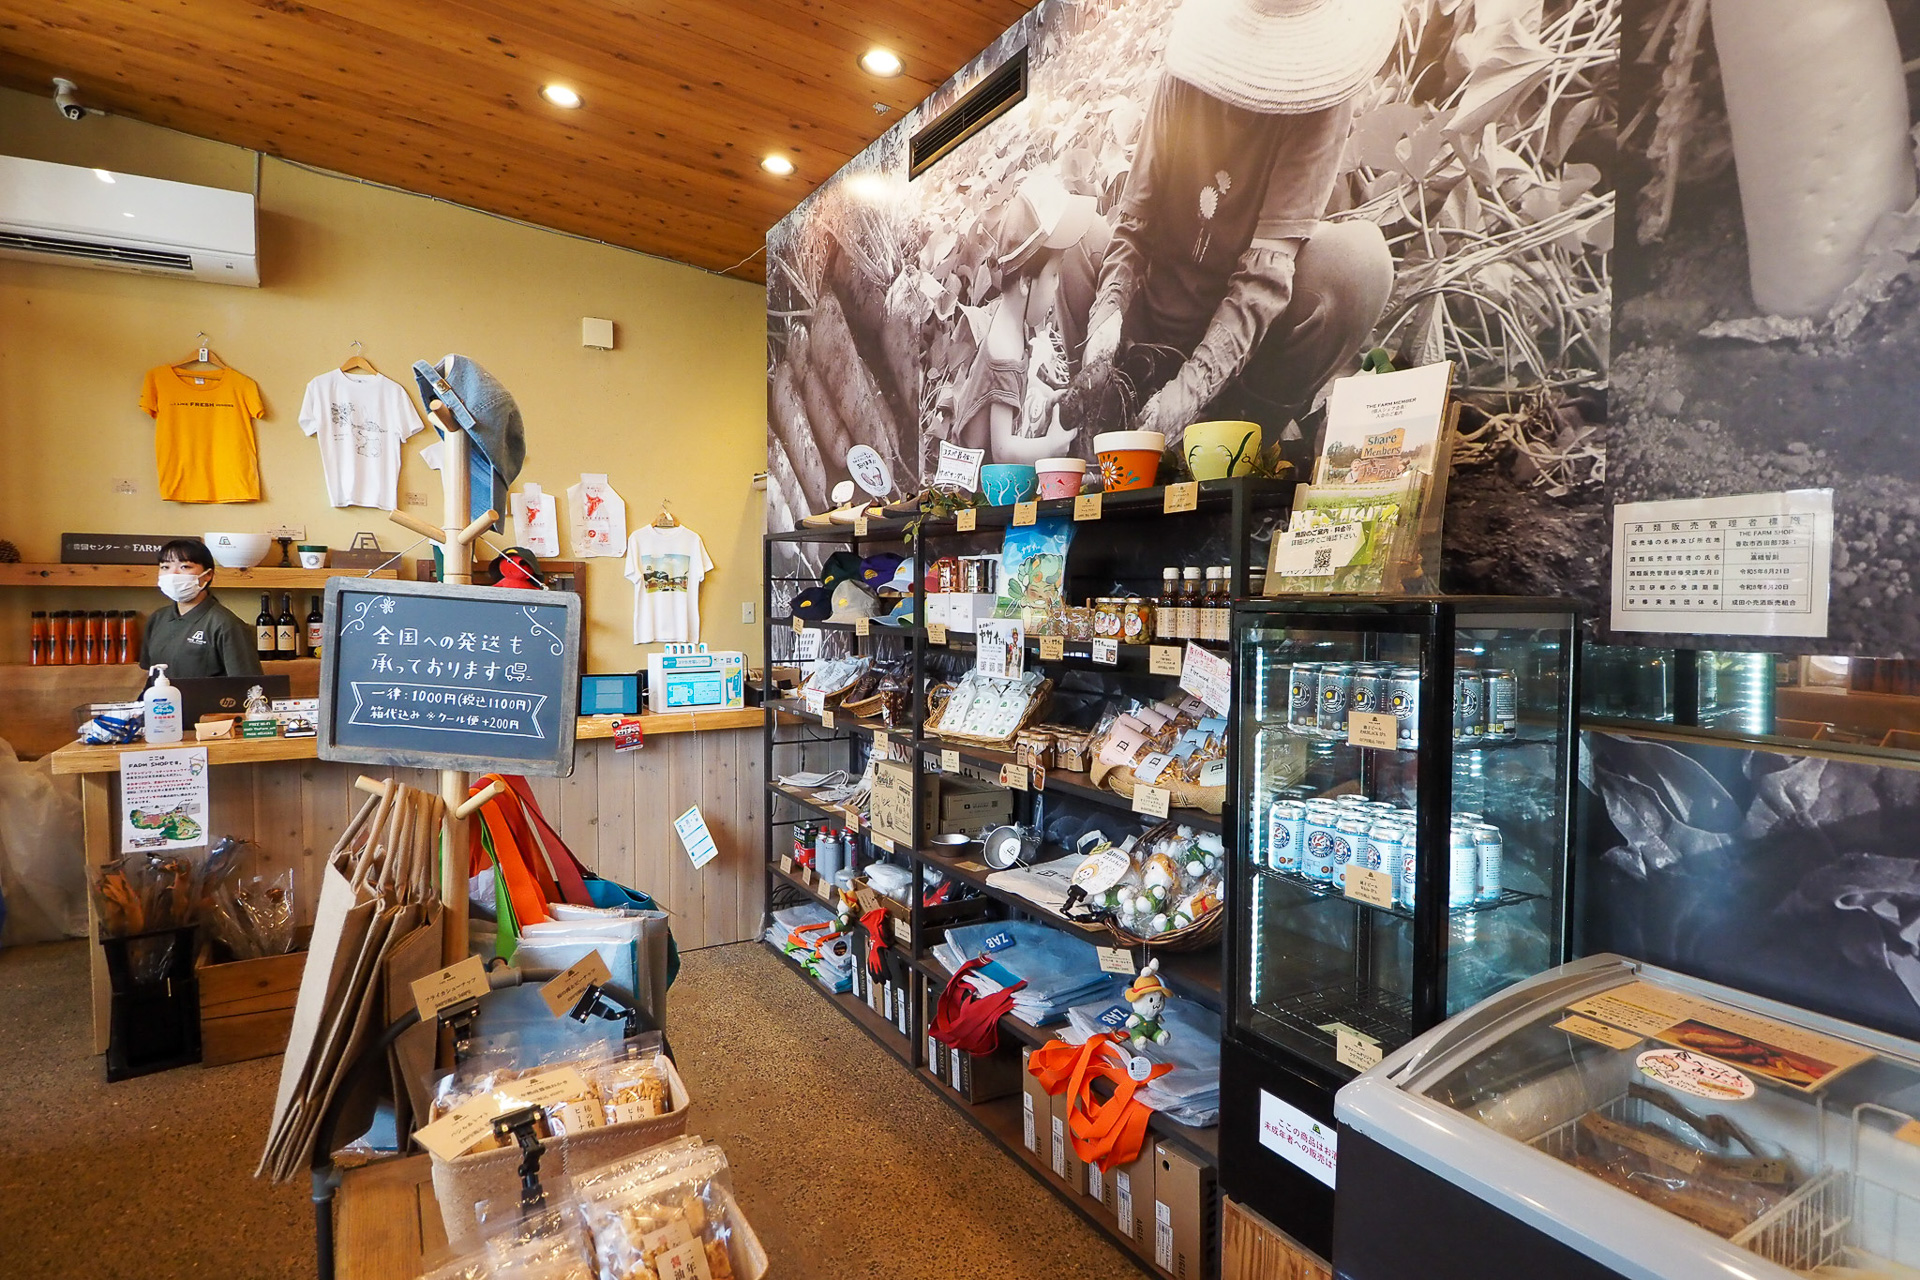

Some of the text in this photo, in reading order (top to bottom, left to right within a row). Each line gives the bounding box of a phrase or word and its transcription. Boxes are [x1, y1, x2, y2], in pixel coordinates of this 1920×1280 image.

[1367, 433, 1398, 446] Share
[1364, 446, 1401, 457] Members
[132, 543, 162, 552] FARM
[372, 625, 523, 655] 全国への発送も
[371, 653, 501, 681] 承っております
[221, 698, 236, 708] hp
[370, 705, 420, 721] 箱代込み
[1264, 1121, 1337, 1169] 未成年者への販売は
